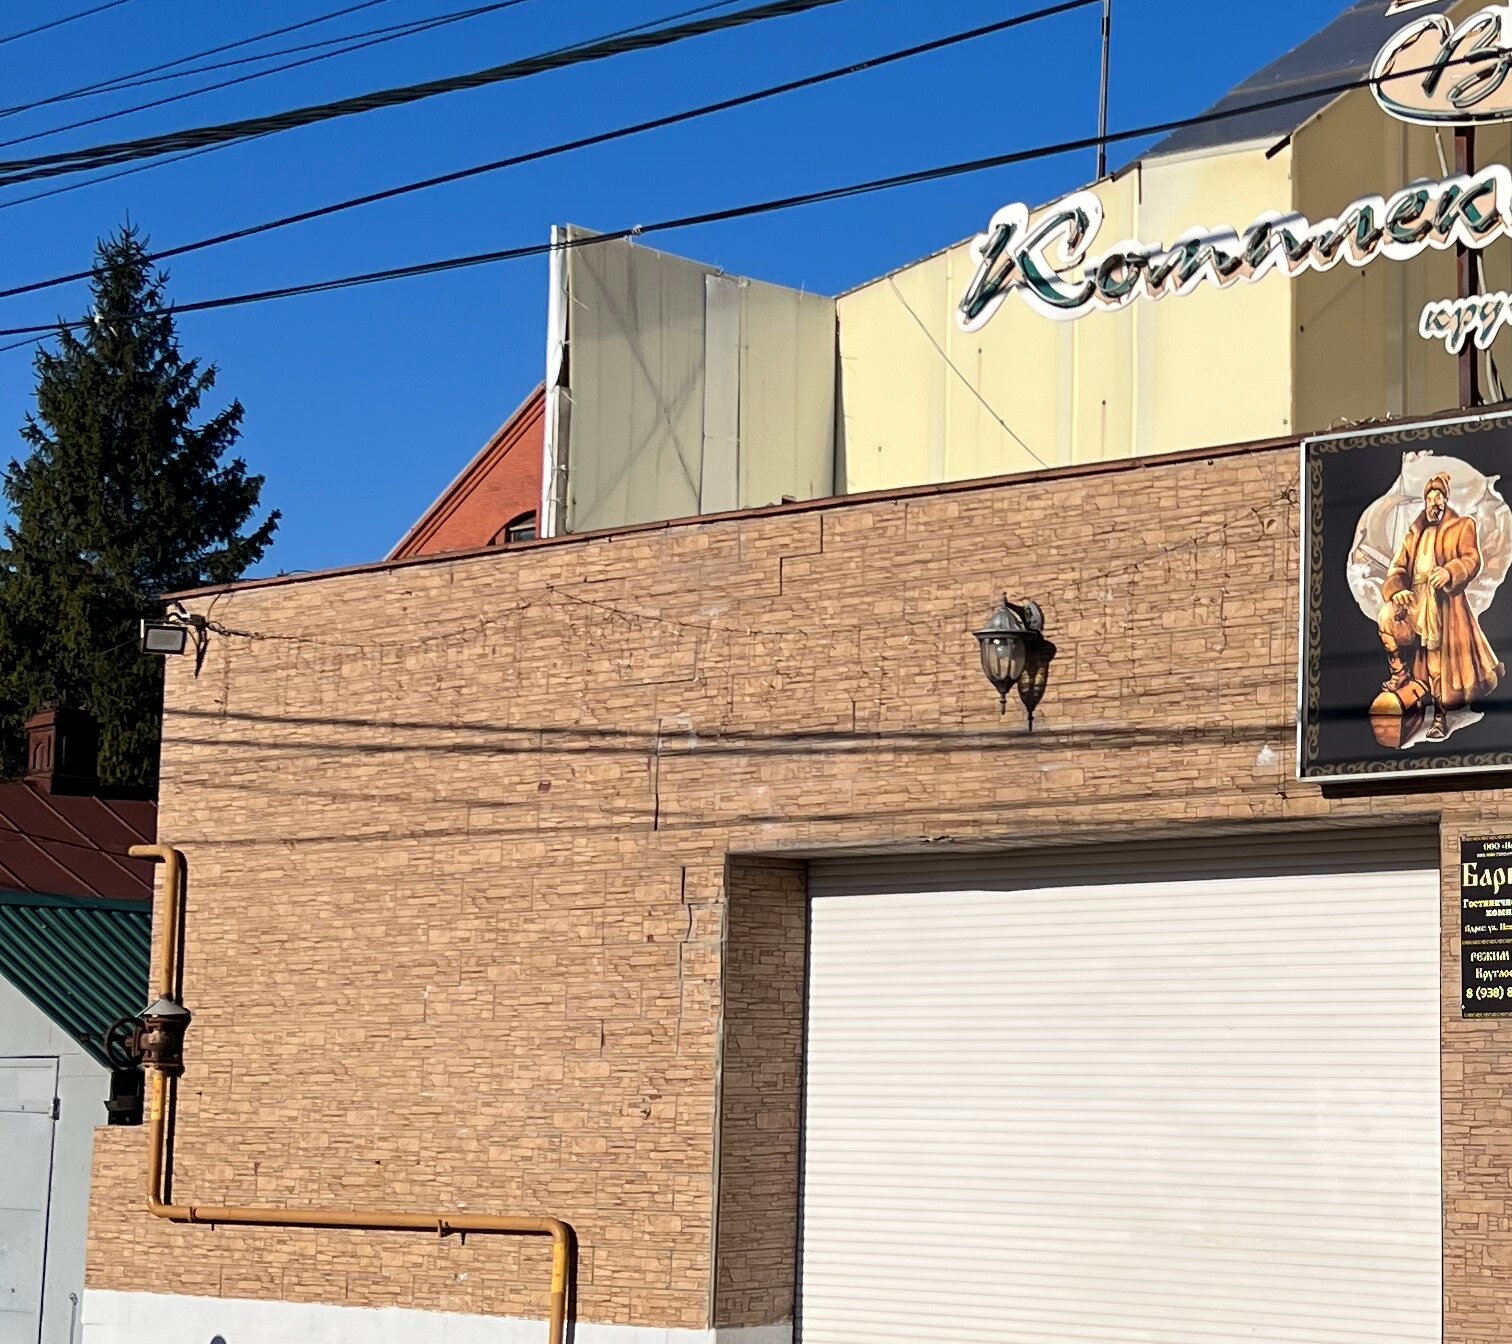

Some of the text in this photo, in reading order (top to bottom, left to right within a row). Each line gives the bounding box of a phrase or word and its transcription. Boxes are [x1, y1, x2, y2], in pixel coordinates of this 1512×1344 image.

[1470, 950, 1510, 962] РЕЖИМ
[1465, 987, 1474, 998] 8
[1475, 986, 1505, 1000] (938)
